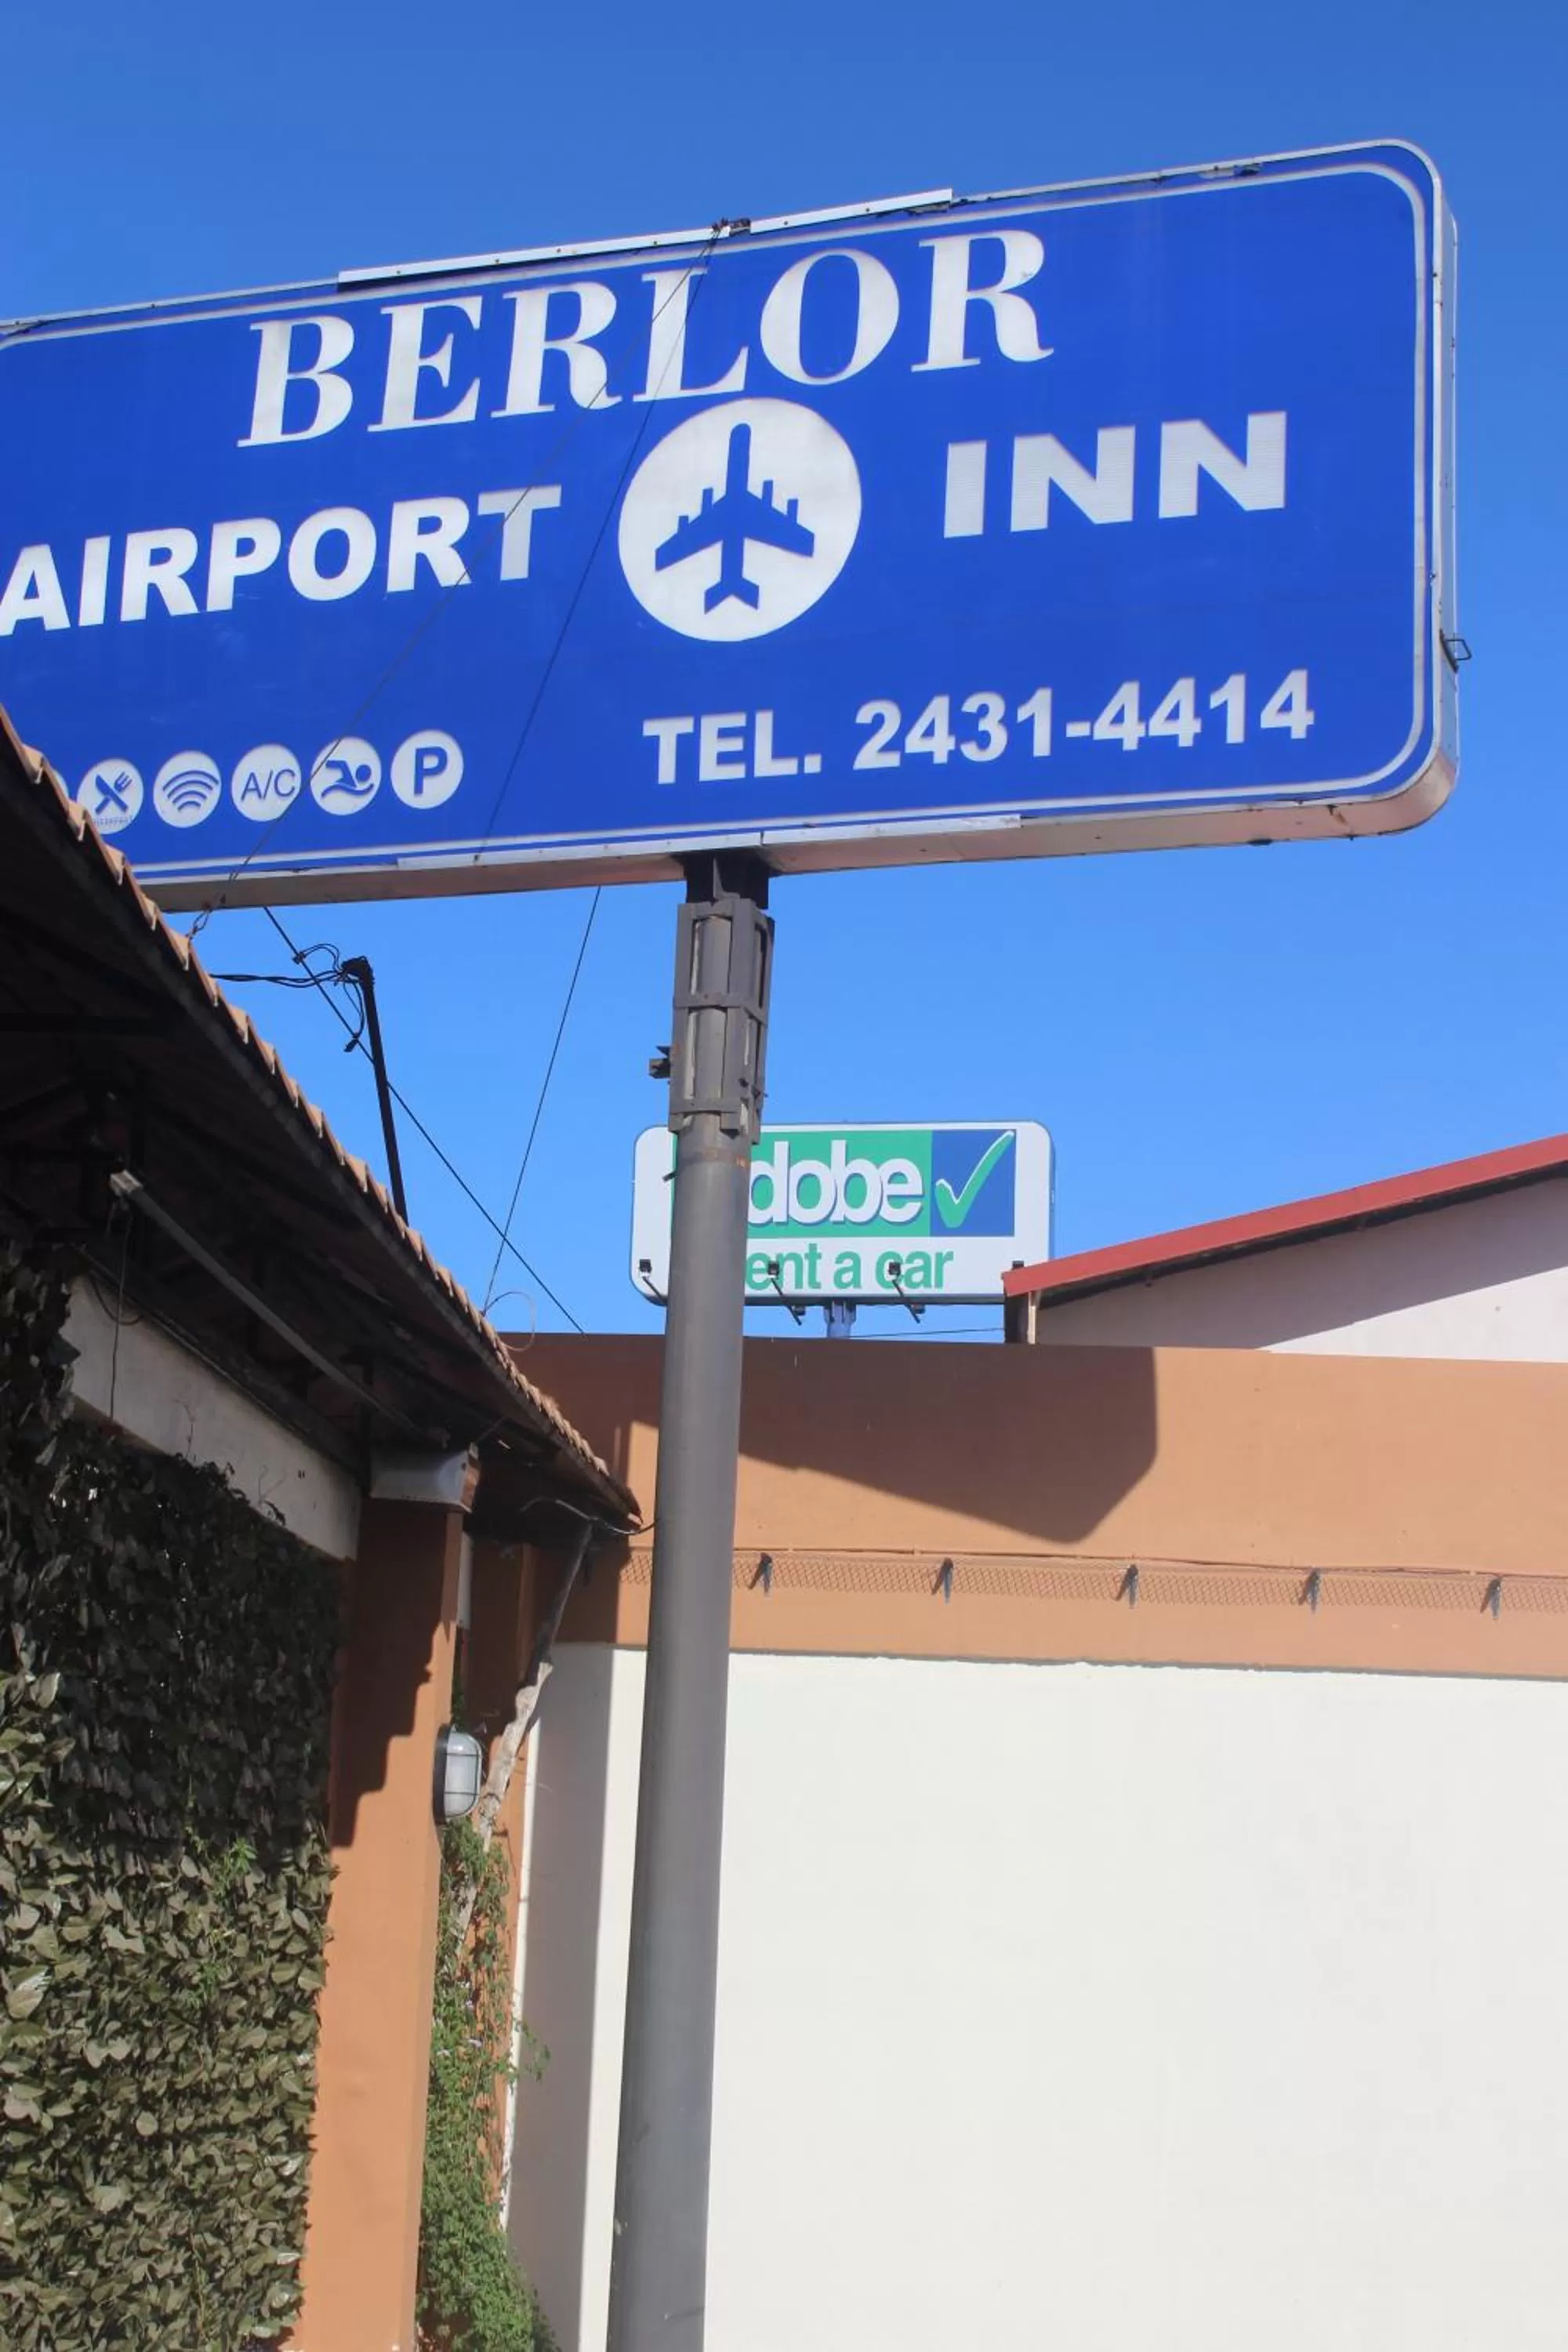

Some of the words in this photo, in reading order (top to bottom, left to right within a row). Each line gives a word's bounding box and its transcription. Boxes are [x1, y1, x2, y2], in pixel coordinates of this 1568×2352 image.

[237, 229, 1054, 447] BERLOR
[0, 485, 562, 637] AIRPORT
[943, 410, 1287, 539] INN
[642, 709, 822, 784] TEL.
[852, 669, 1316, 770] 2431-4414
[241, 768, 296, 801] A/C
[413, 746, 448, 796] P
[748, 1139, 924, 1225] dobe
[746, 1243, 822, 1290] ent
[833, 1250, 862, 1290] a
[876, 1250, 954, 1290] car
